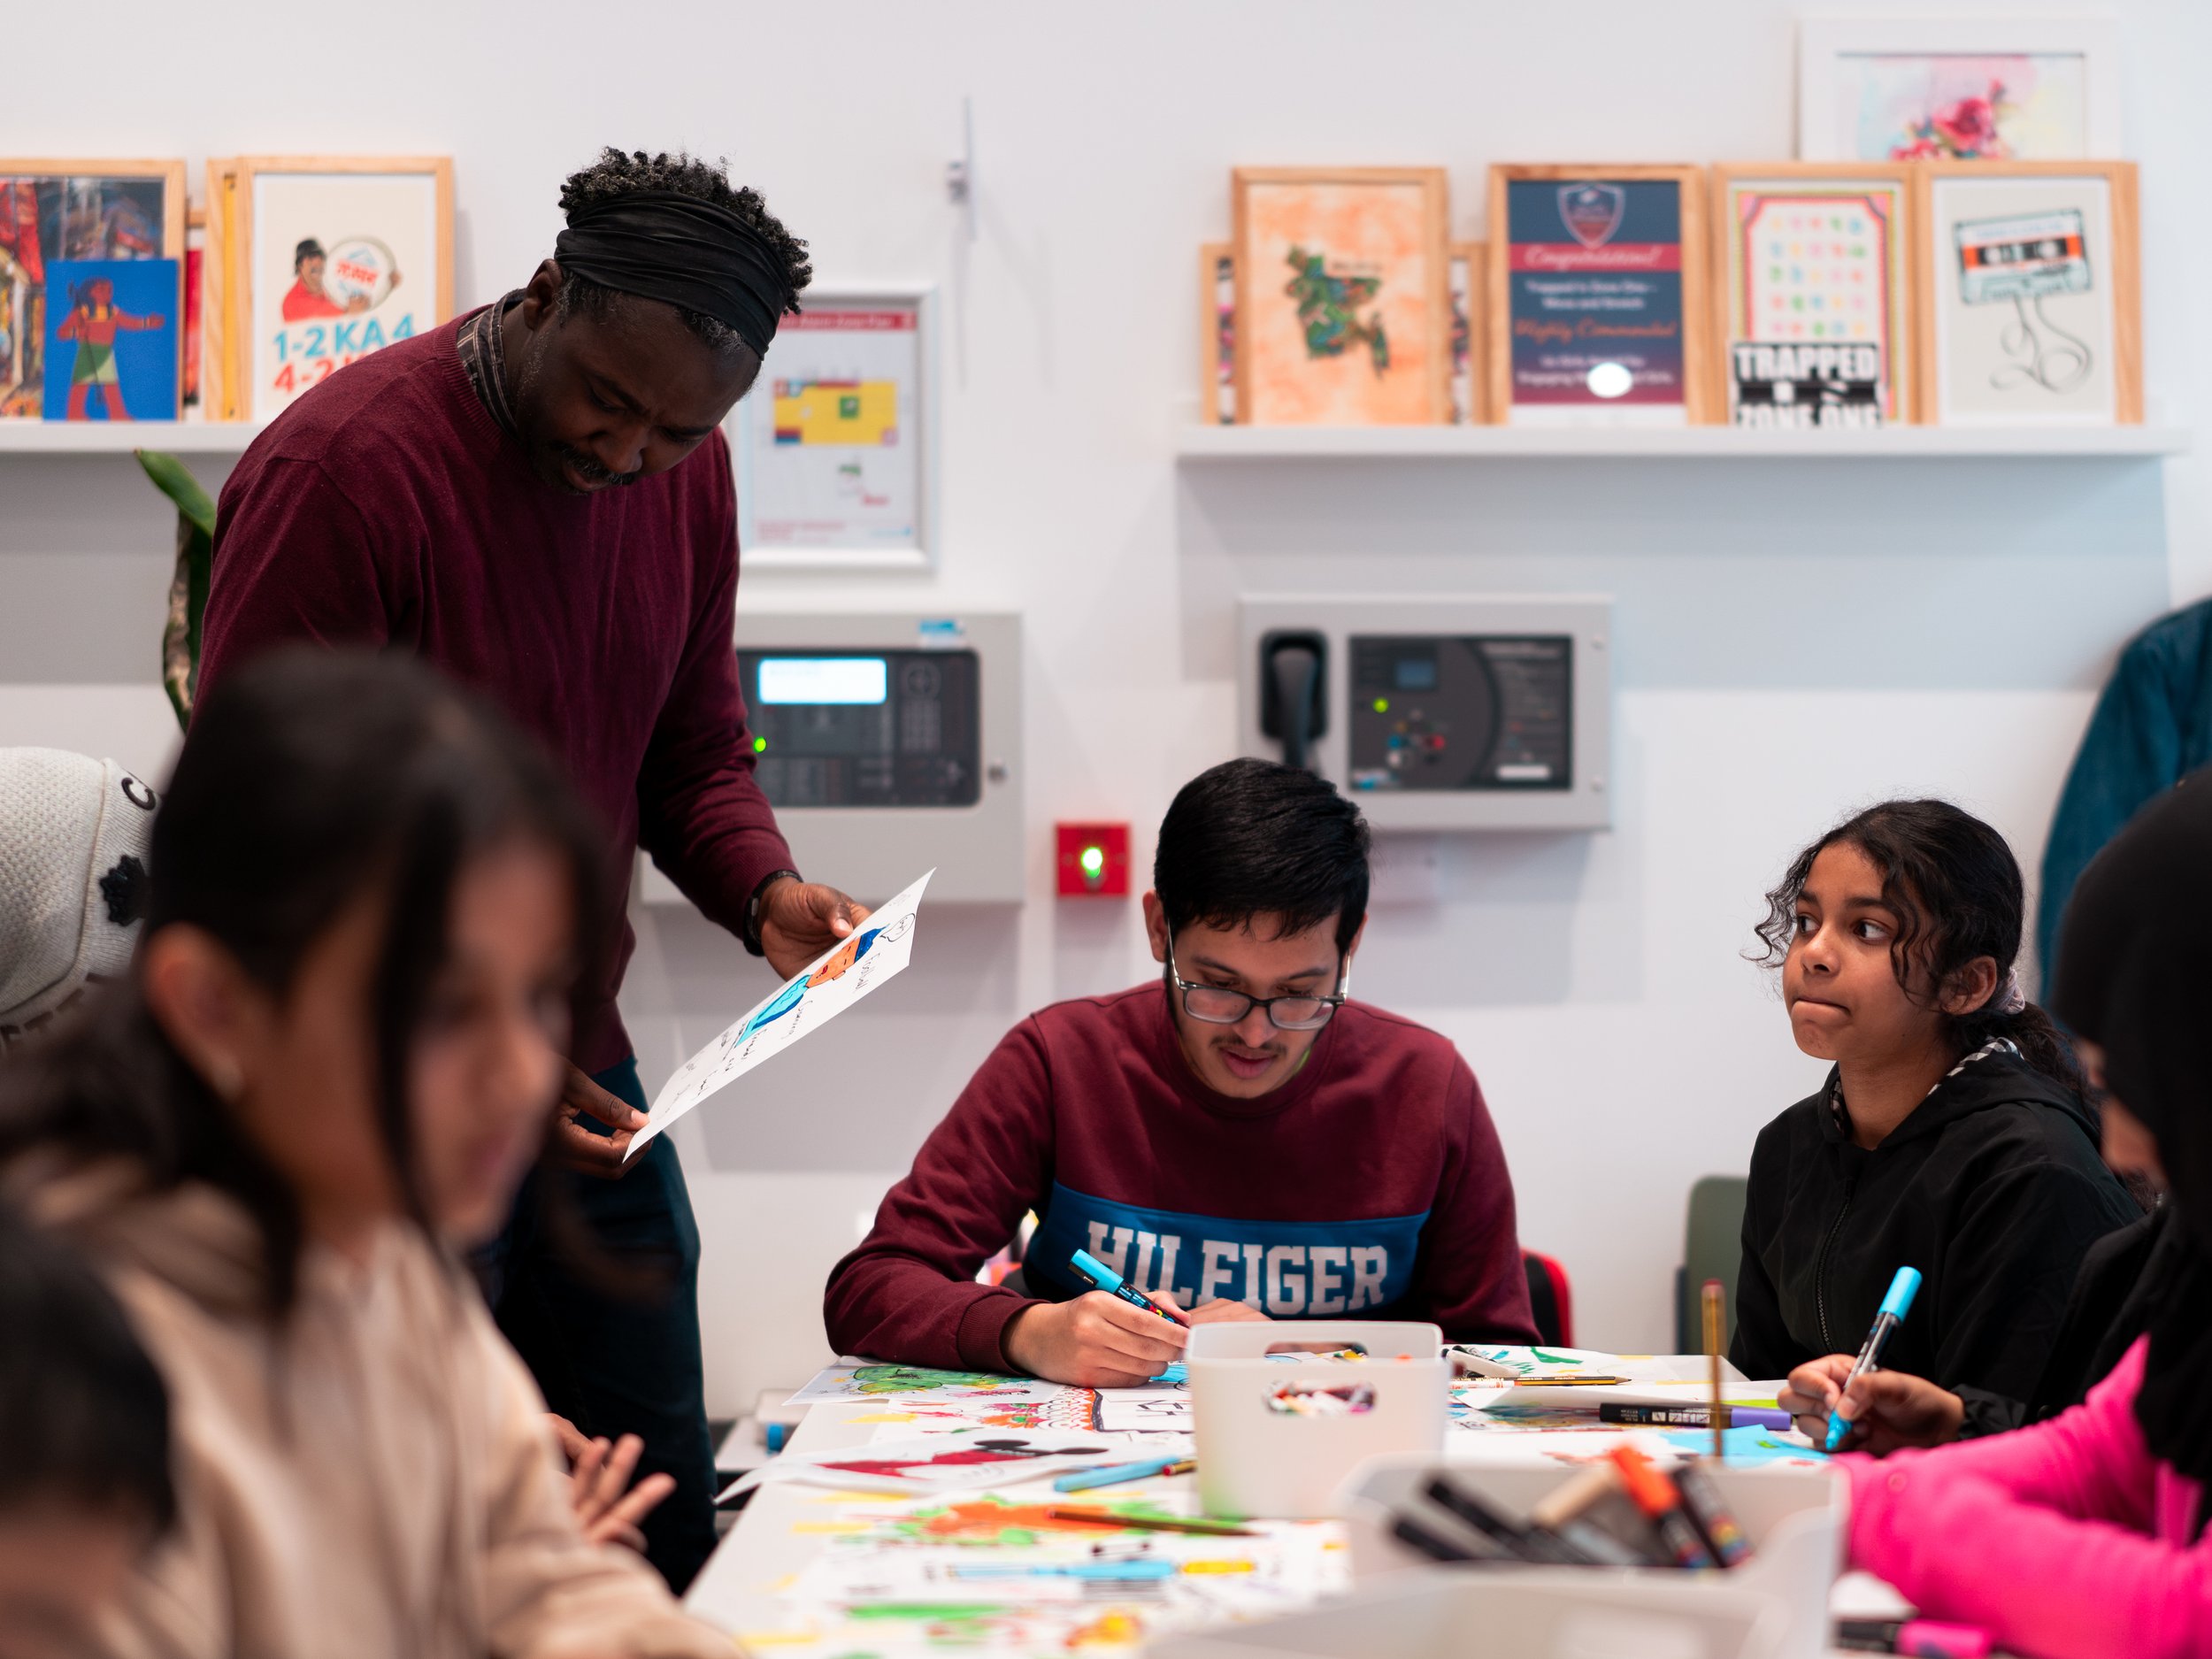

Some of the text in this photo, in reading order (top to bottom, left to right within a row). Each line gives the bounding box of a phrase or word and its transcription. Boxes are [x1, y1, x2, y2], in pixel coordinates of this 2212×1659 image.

[273, 313, 414, 362] 1-2 KA 4
[1735, 344, 1878, 380] TRAPPED
[1087, 1222, 1387, 1316] HILFIGER
